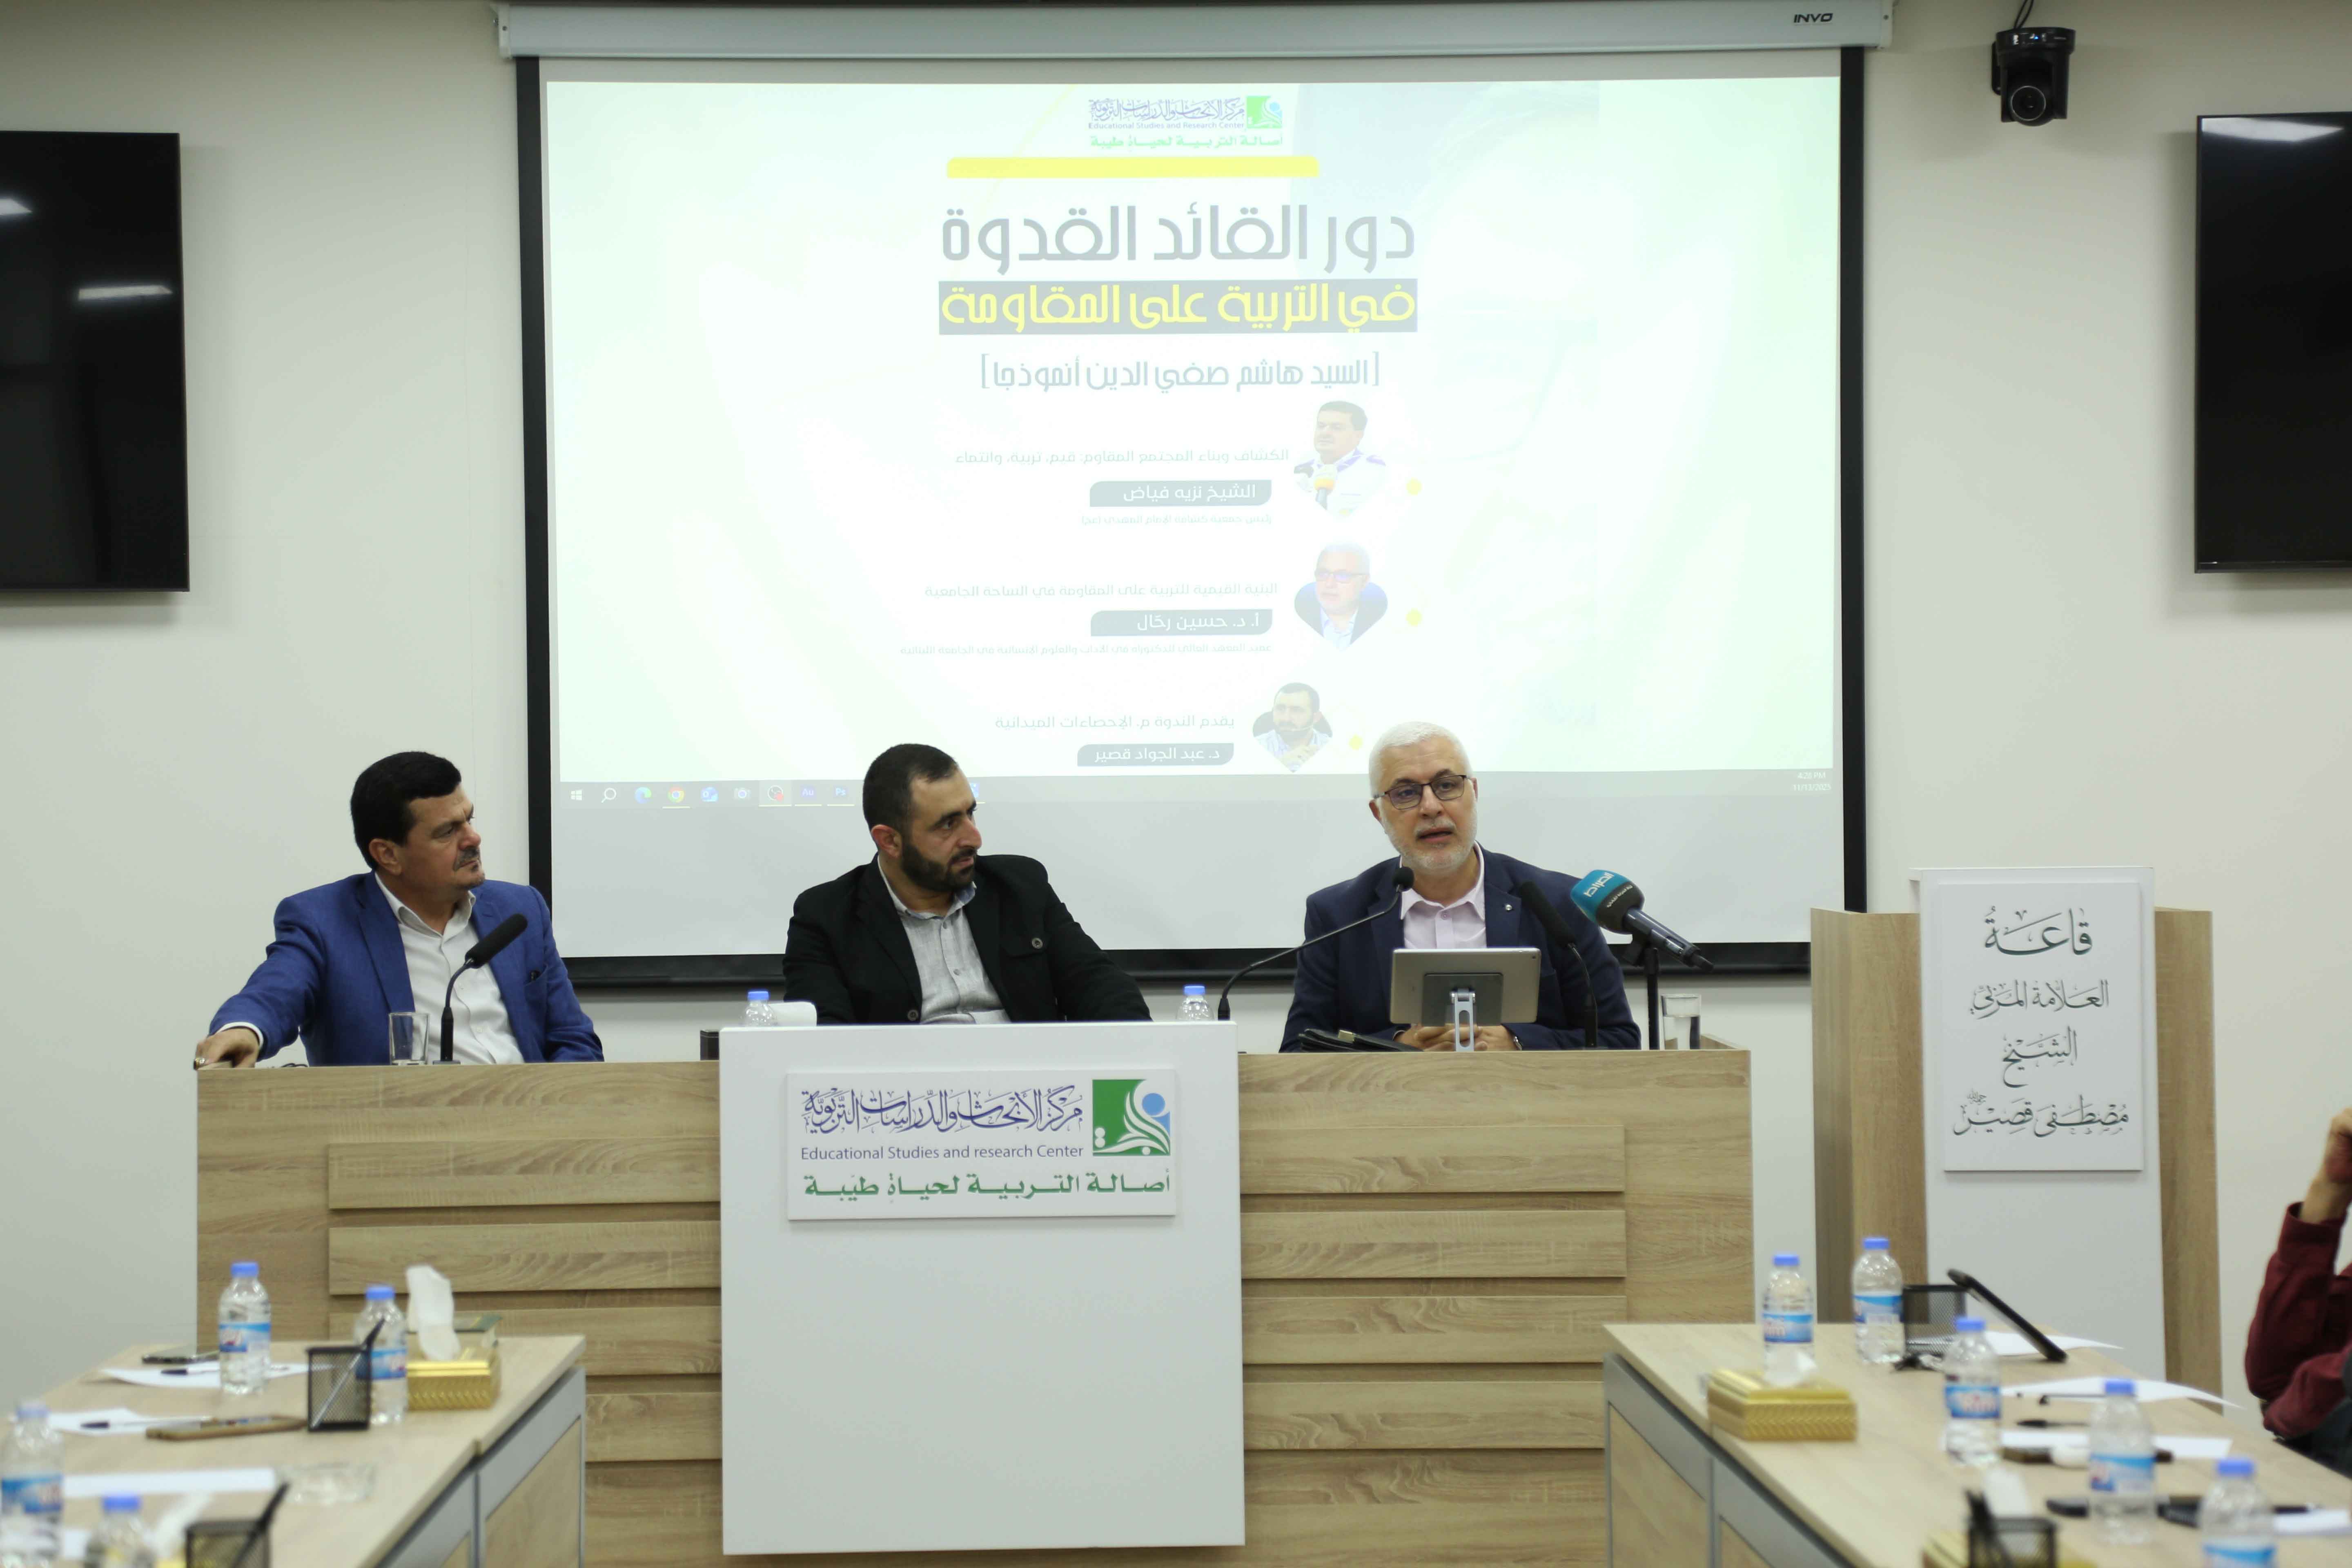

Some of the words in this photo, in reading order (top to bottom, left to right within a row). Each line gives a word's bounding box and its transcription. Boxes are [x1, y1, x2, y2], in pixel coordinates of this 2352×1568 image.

[1794, 13, 1833, 23] INVO
[1154, 202, 1307, 260] القائد
[943, 206, 1136, 275] القدوة
[1323, 216, 1415, 274] دور
[942, 285, 1120, 332] المقاومة
[1130, 285, 1206, 329] على
[1218, 283, 1328, 330] التربية
[1339, 284, 1415, 333] في
[1086, 361, 1148, 391] الدين
[1155, 362, 1229, 393] صفي
[1236, 359, 1303, 392] هاشم
[954, 452, 1002, 466] وانتماء
[1139, 451, 1193, 464] المجتمع
[1123, 485, 1168, 502] فياض
[1175, 485, 1202, 503] نزيه
[1207, 483, 1255, 501] الشيخ
[924, 586, 979, 599] الجامعية
[983, 585, 1027, 597] الساحة
[1033, 586, 1055, 598] في
[1059, 584, 1113, 598] المقاومة
[1118, 584, 1146, 595] على
[1194, 583, 1240, 597] القيمية
[1245, 583, 1277, 597] البنية
[1177, 616, 1227, 630] حسين
[1232, 616, 1245, 627] د.
[995, 717, 1055, 731] الميدانية
[1155, 715, 1195, 729] الندوة
[1199, 717, 1234, 728] يقدم
[1094, 748, 1130, 763] قصير
[1135, 747, 1176, 763] الجواد
[1180, 749, 1204, 761] عبد
[1209, 749, 1220, 758] د.
[801, 1146, 884, 1160] Educational
[889, 1146, 939, 1160] Studies
[943, 1146, 969, 1159] and
[975, 1146, 1032, 1159] research
[1036, 1145, 1083, 1158] Center
[967, 1174, 1079, 1200] التربية
[1086, 1169, 1169, 1193] أصالة
